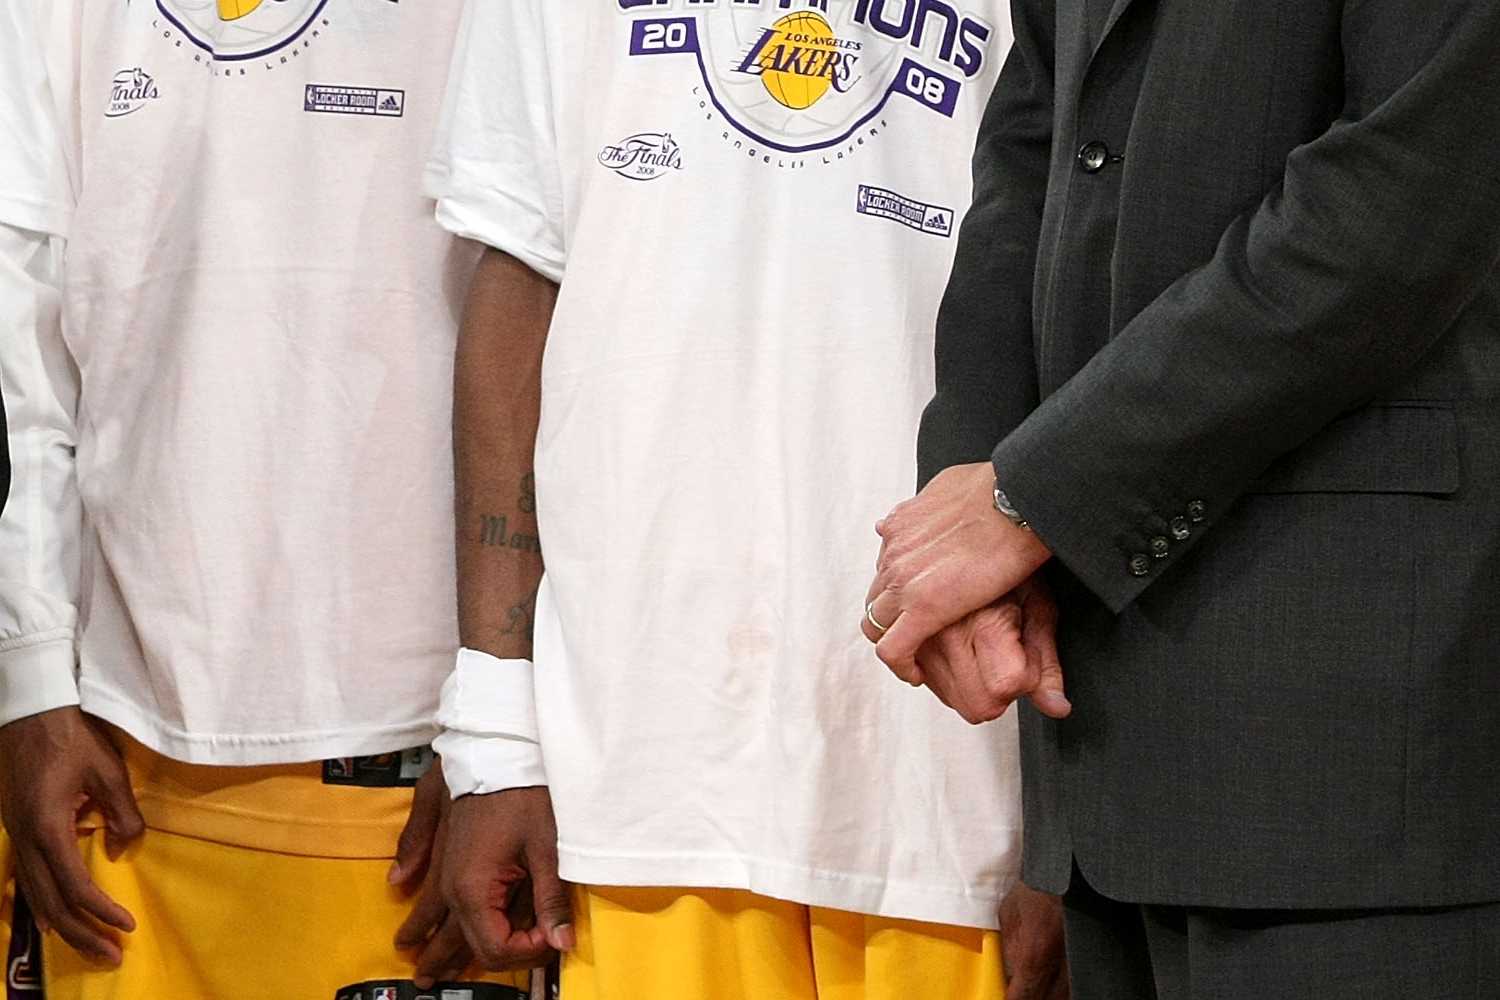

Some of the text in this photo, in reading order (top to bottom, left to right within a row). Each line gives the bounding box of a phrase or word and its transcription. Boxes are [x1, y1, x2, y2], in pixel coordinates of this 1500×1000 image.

[152, 19, 182, 47] LOS
[266, 18, 330, 70] LAKERS
[642, 22, 687, 50] 20
[784, 32, 863, 51] LOS ANGELES
[733, 28, 861, 93] LAKERS
[315, 93, 376, 107] LOCKER ROOM
[905, 71, 945, 104] 08
[692, 85, 888, 169] LOS ANGELES LAKERS
[600, 139, 684, 171] The Finals
[635, 165, 656, 176] 2008
[867, 195, 901, 214] LOCKER
